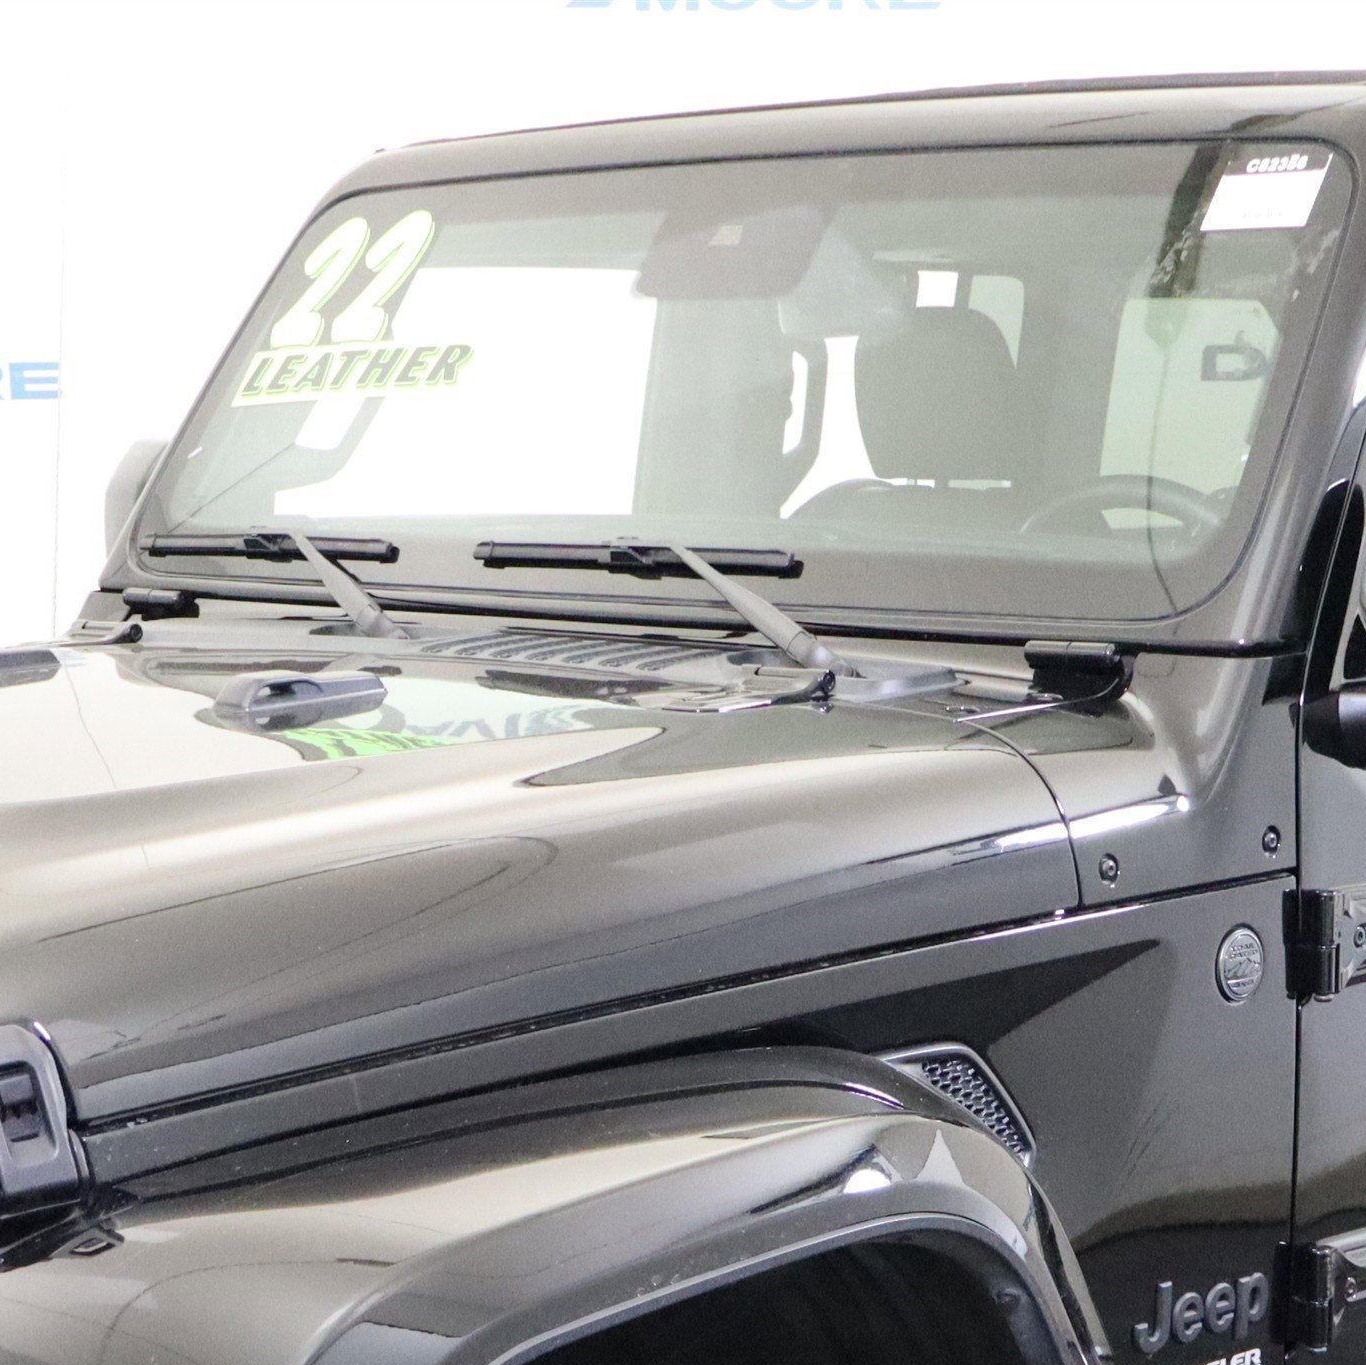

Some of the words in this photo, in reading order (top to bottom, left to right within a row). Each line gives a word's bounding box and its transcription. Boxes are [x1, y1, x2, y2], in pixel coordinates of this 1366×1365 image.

[269, 209, 437, 350] 22
[239, 343, 475, 398] LEATHER
[1132, 1271, 1270, 1354] Jeep
